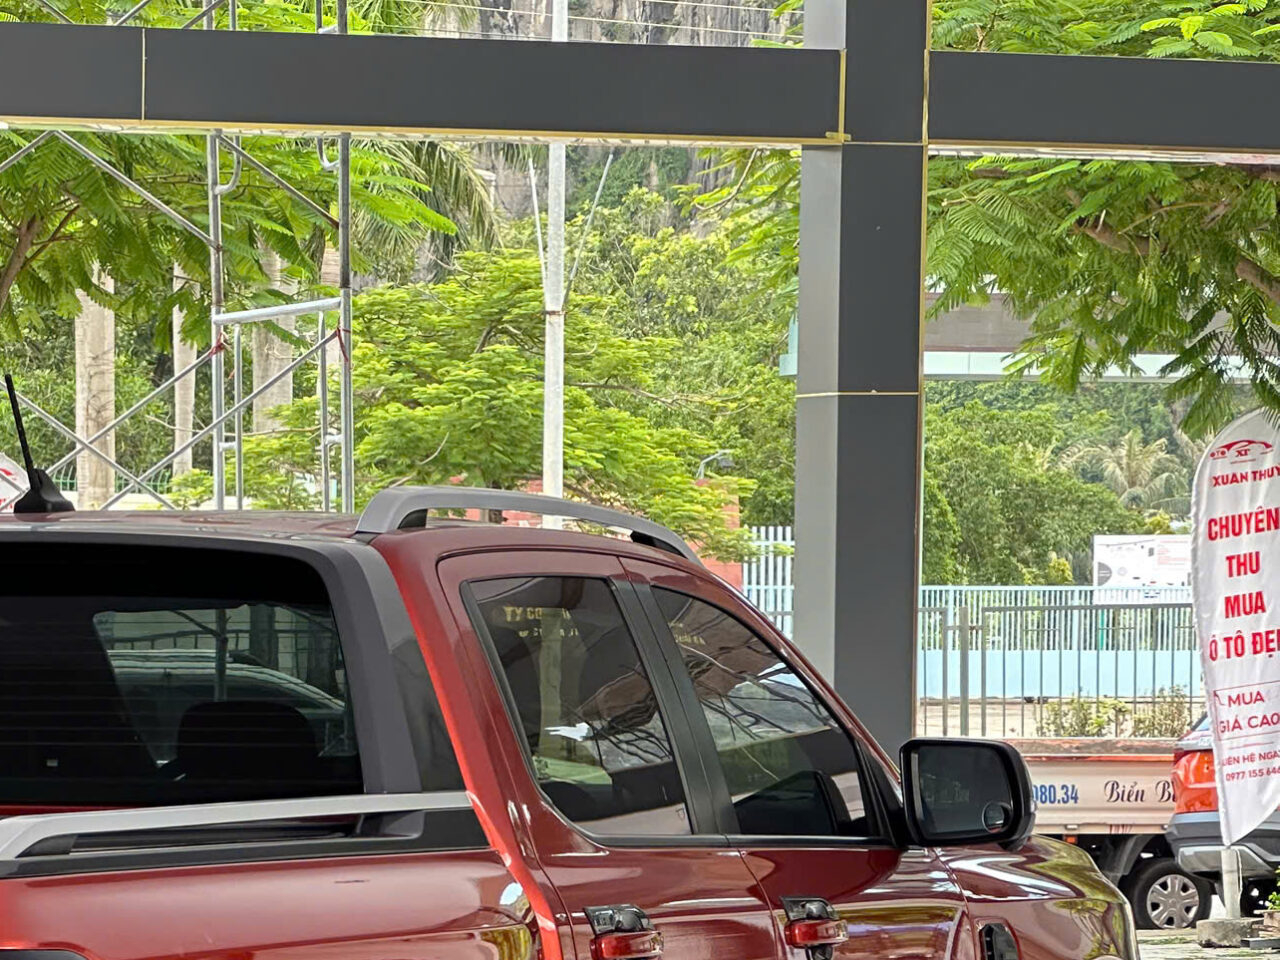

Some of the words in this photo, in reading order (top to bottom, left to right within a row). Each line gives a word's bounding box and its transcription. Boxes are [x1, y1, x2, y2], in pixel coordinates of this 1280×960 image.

[1207, 506, 1280, 541] CHUYÊN
[1225, 551, 1261, 578] THU
[1224, 591, 1267, 619] MUA
[1223, 630, 1246, 660] TÔ
[1227, 690, 1265, 708] MUA
[1247, 712, 1280, 729] CAO
[1258, 749, 1280, 761] NGA
[1225, 771, 1246, 782] 0977
